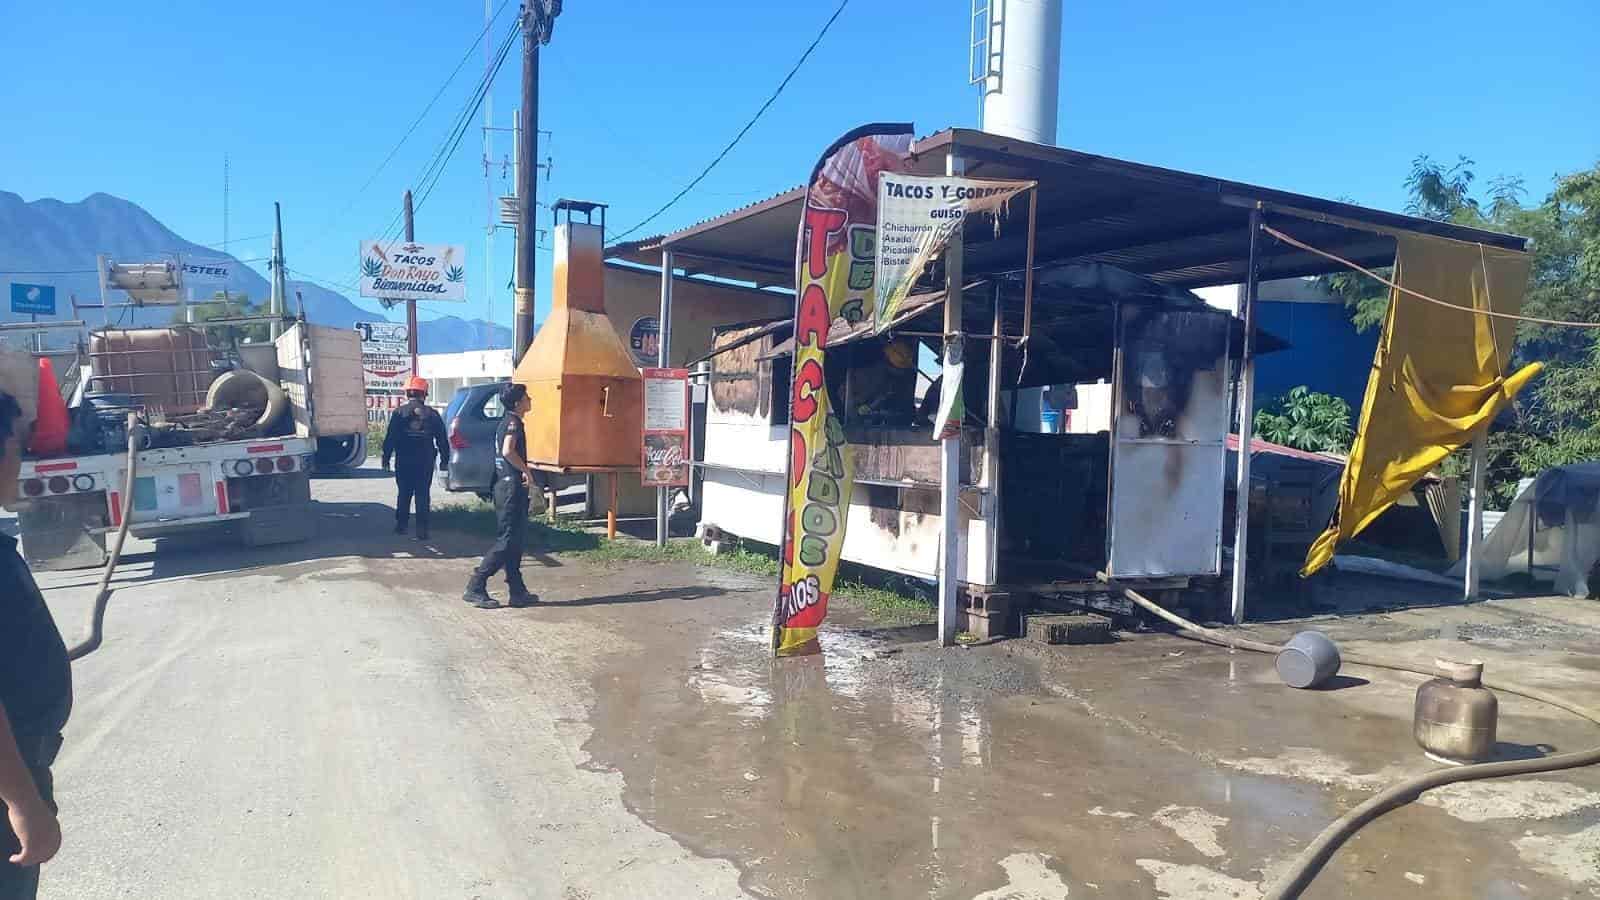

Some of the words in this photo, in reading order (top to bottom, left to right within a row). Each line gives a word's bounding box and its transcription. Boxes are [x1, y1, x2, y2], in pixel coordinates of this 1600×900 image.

[886, 182, 933, 198] TACOS
[941, 185, 950, 198] Y
[930, 209, 963, 219] GUISO
[394, 254, 436, 266] TACOS
[848, 225, 876, 290] DE
[382, 265, 406, 279] Don
[406, 266, 440, 282] Rayo
[372, 278, 447, 294] Bienvenidos
